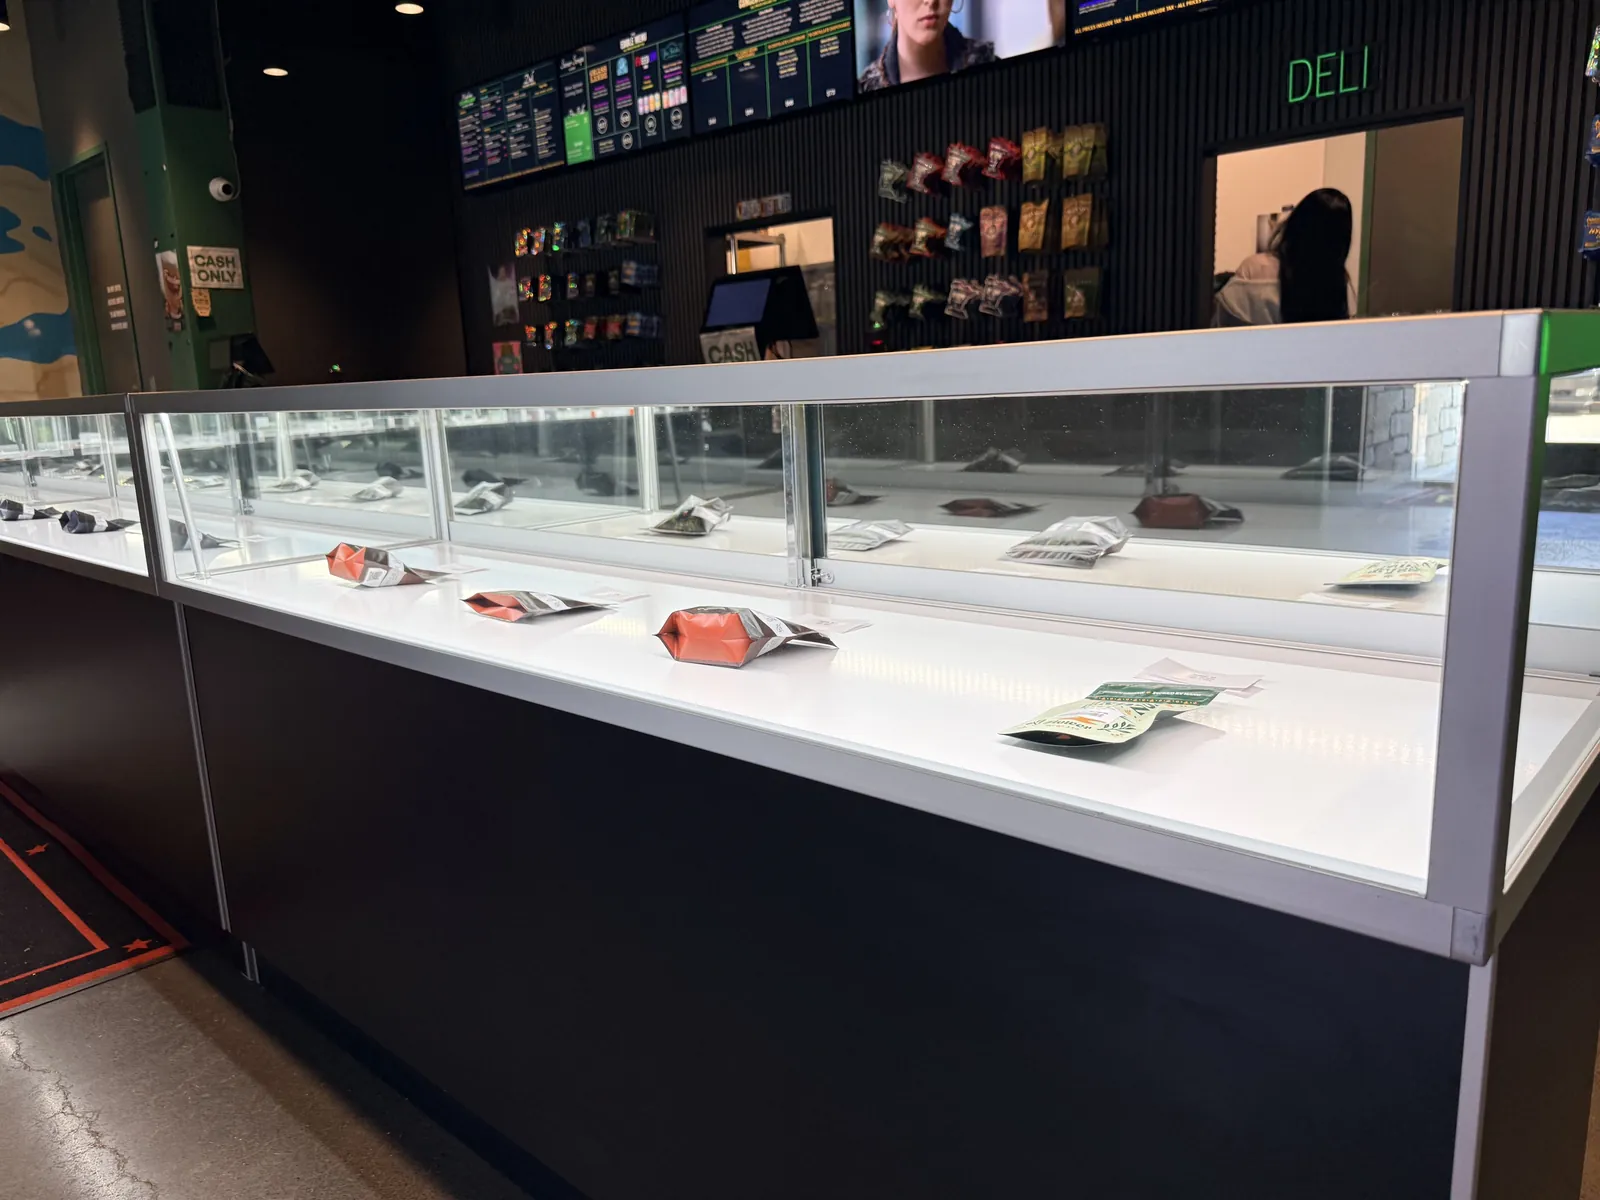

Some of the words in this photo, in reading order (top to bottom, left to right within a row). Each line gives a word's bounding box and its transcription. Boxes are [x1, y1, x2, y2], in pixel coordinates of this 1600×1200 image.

[1288, 44, 1368, 103] DELI
[195, 254, 235, 268] CASH
[197, 269, 236, 283] ONLY
[708, 341, 757, 363] CASH
